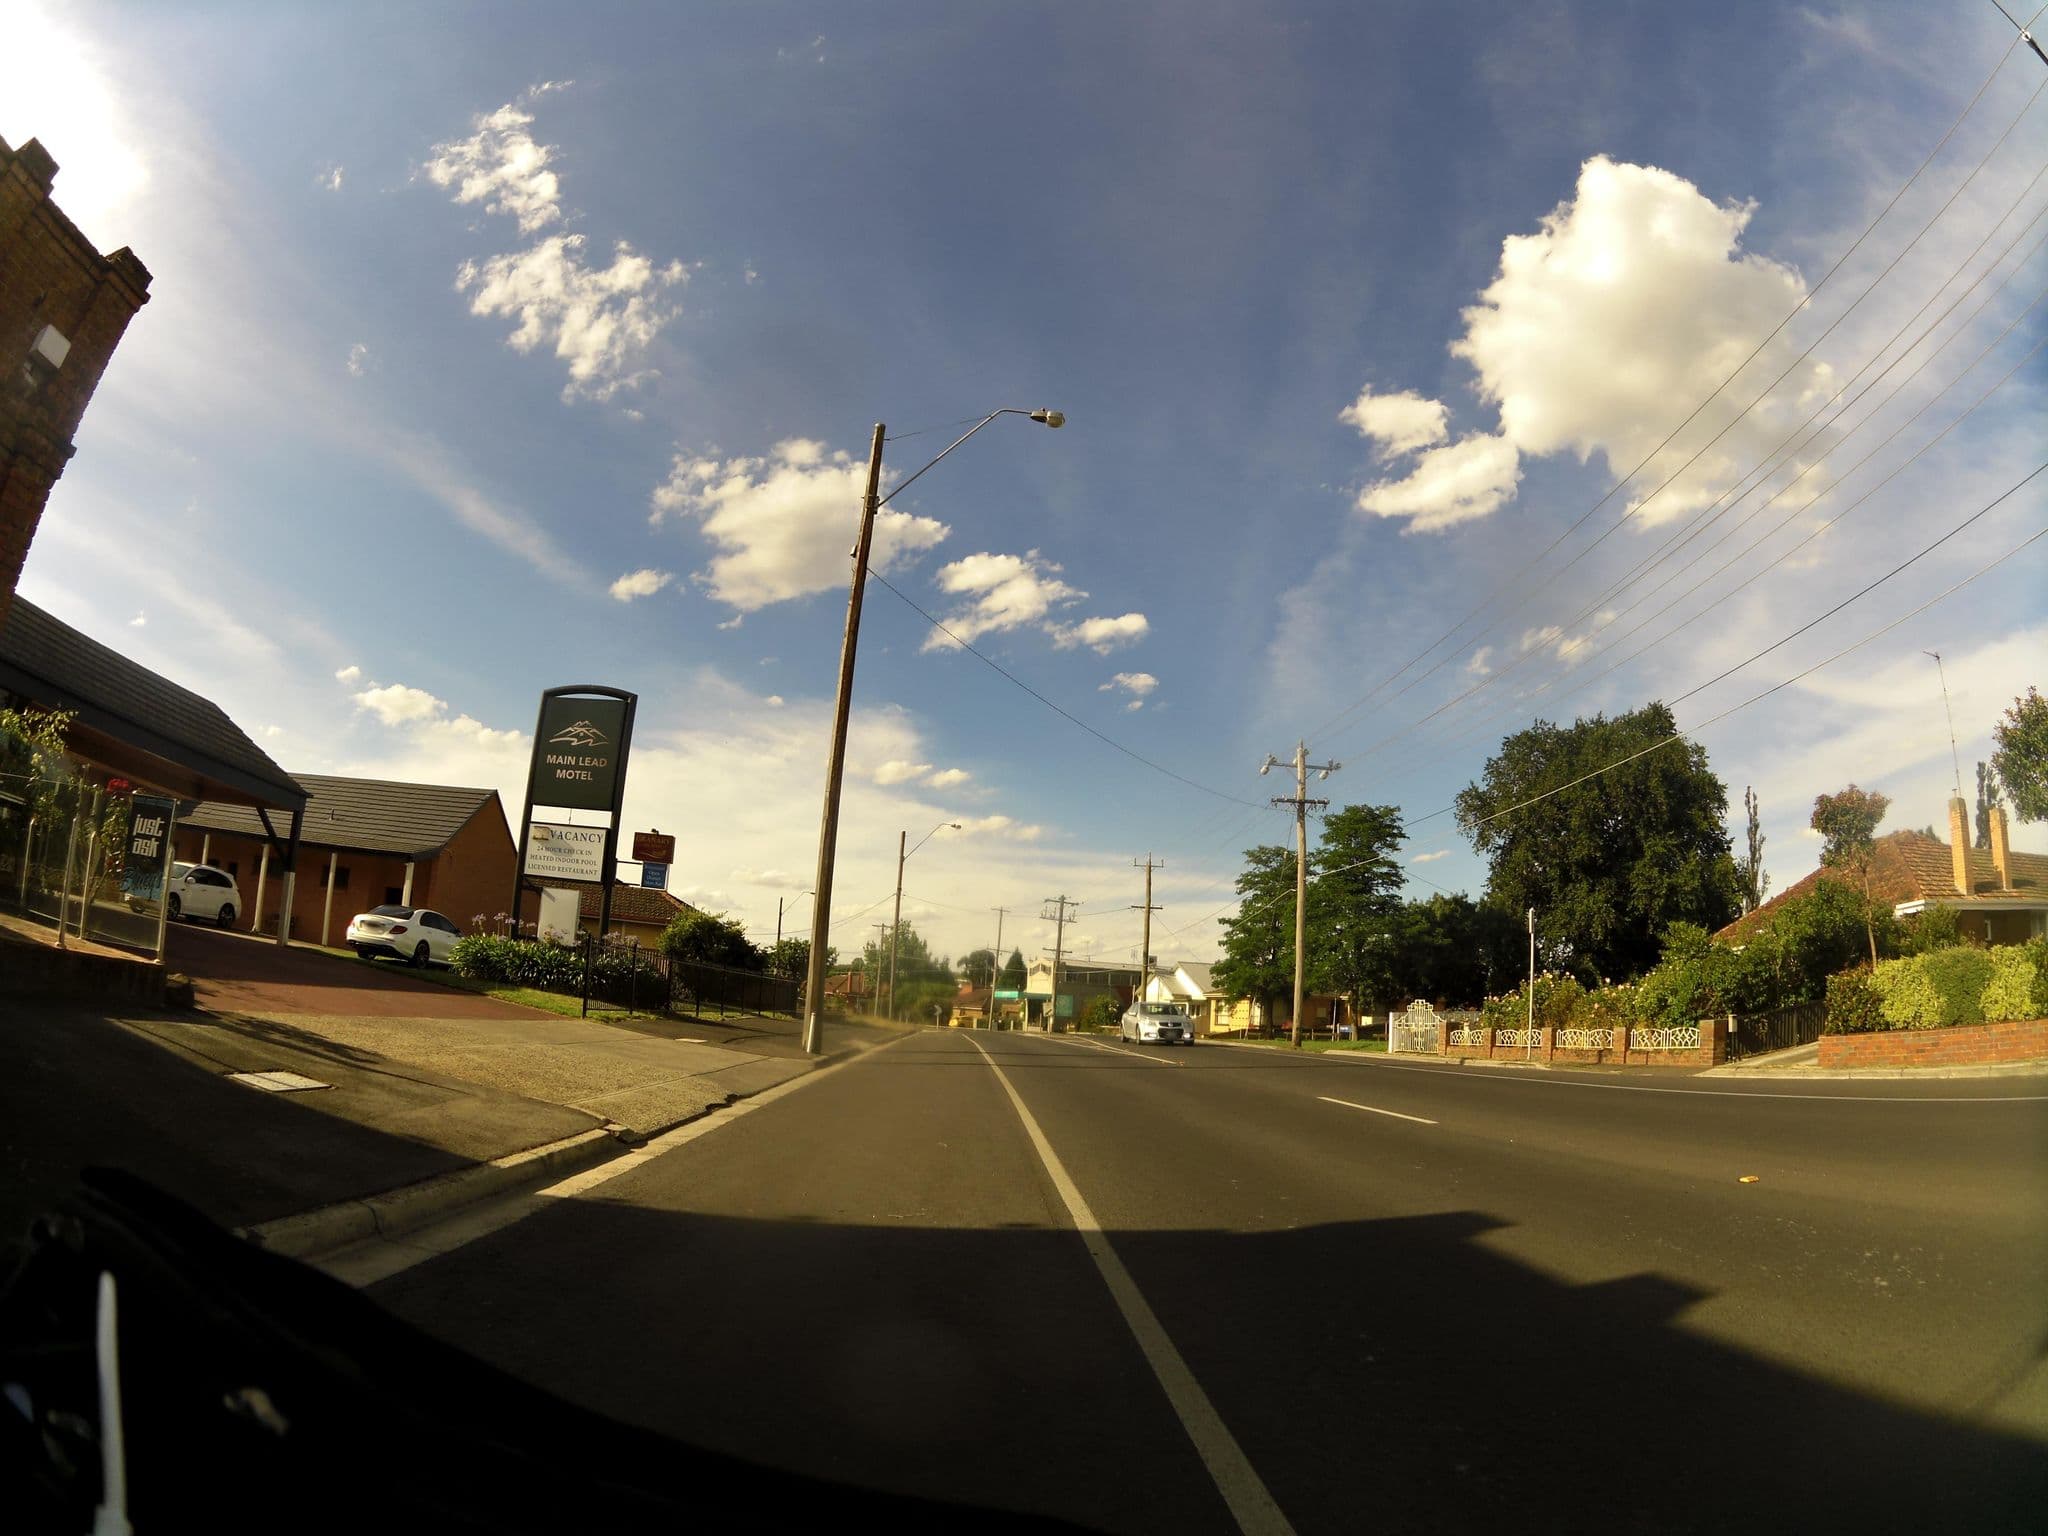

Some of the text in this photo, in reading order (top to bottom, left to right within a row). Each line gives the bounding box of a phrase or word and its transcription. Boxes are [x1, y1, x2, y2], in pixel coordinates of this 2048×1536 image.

[546, 754, 608, 767] MAIN LEAD
[556, 769, 593, 781] MOTEL
[133, 814, 165, 837] just
[550, 829, 603, 843] VACANCY
[132, 837, 160, 858] ask
[545, 846, 562, 854] HOUR
[563, 847, 584, 855] CHECK
[530, 853, 555, 862] HEATED
[555, 856, 580, 864] INDOOR
[528, 863, 598, 876] LICENSED RESTAURANT
